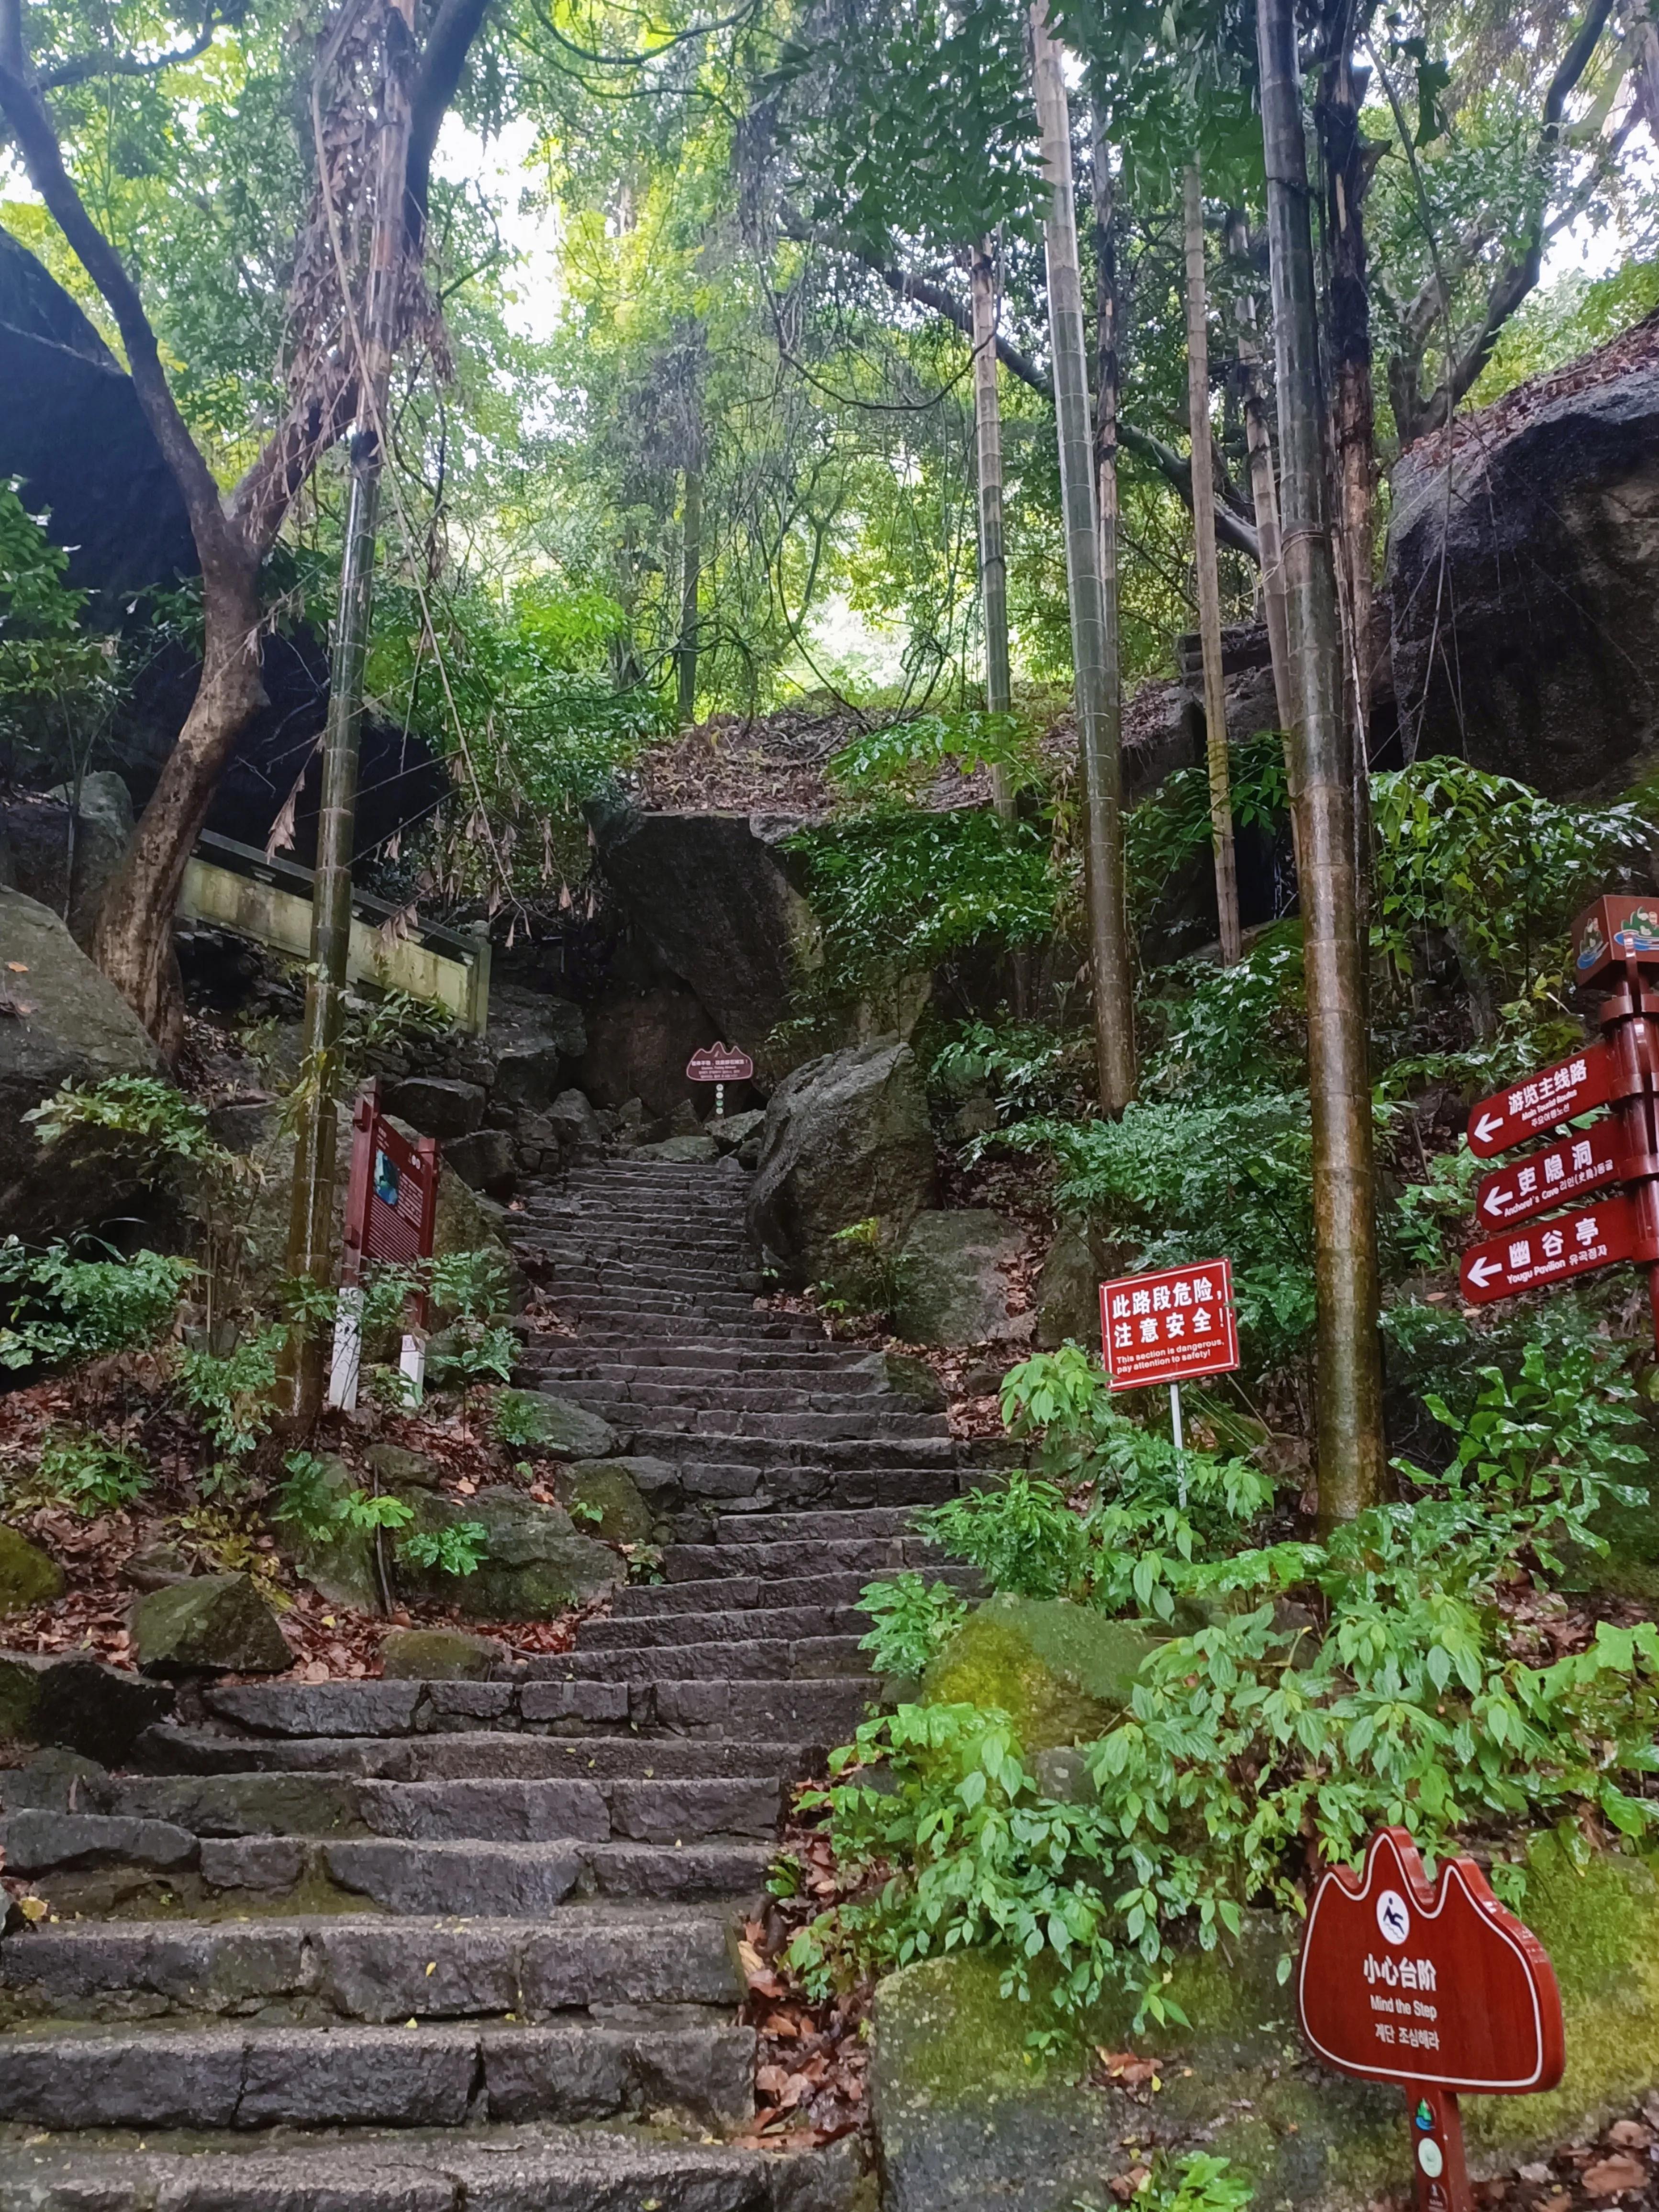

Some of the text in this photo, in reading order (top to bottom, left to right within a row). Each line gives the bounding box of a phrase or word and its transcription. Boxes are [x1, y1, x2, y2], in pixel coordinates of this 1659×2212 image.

[1508, 1059, 1587, 1115] 游览主线路
[1522, 1109, 1537, 1121] Main
[1537, 1098, 1556, 1112] Tourist
[1542, 1187, 1559, 1199] Cave
[1509, 1217, 1598, 1268] 幽谷亭
[1507, 1260, 1566, 1284] Yougu Pavilion
[1117, 1364, 1132, 1374] pay
[1134, 1357, 1170, 1370] attention
[1182, 1349, 1211, 1361] safety!
[1136, 1349, 1166, 1361] section
[1364, 1953, 1436, 1991] 小心台阶
[1370, 1994, 1437, 2022] Mind the Step
[1375, 2023, 1395, 2044] 계단
